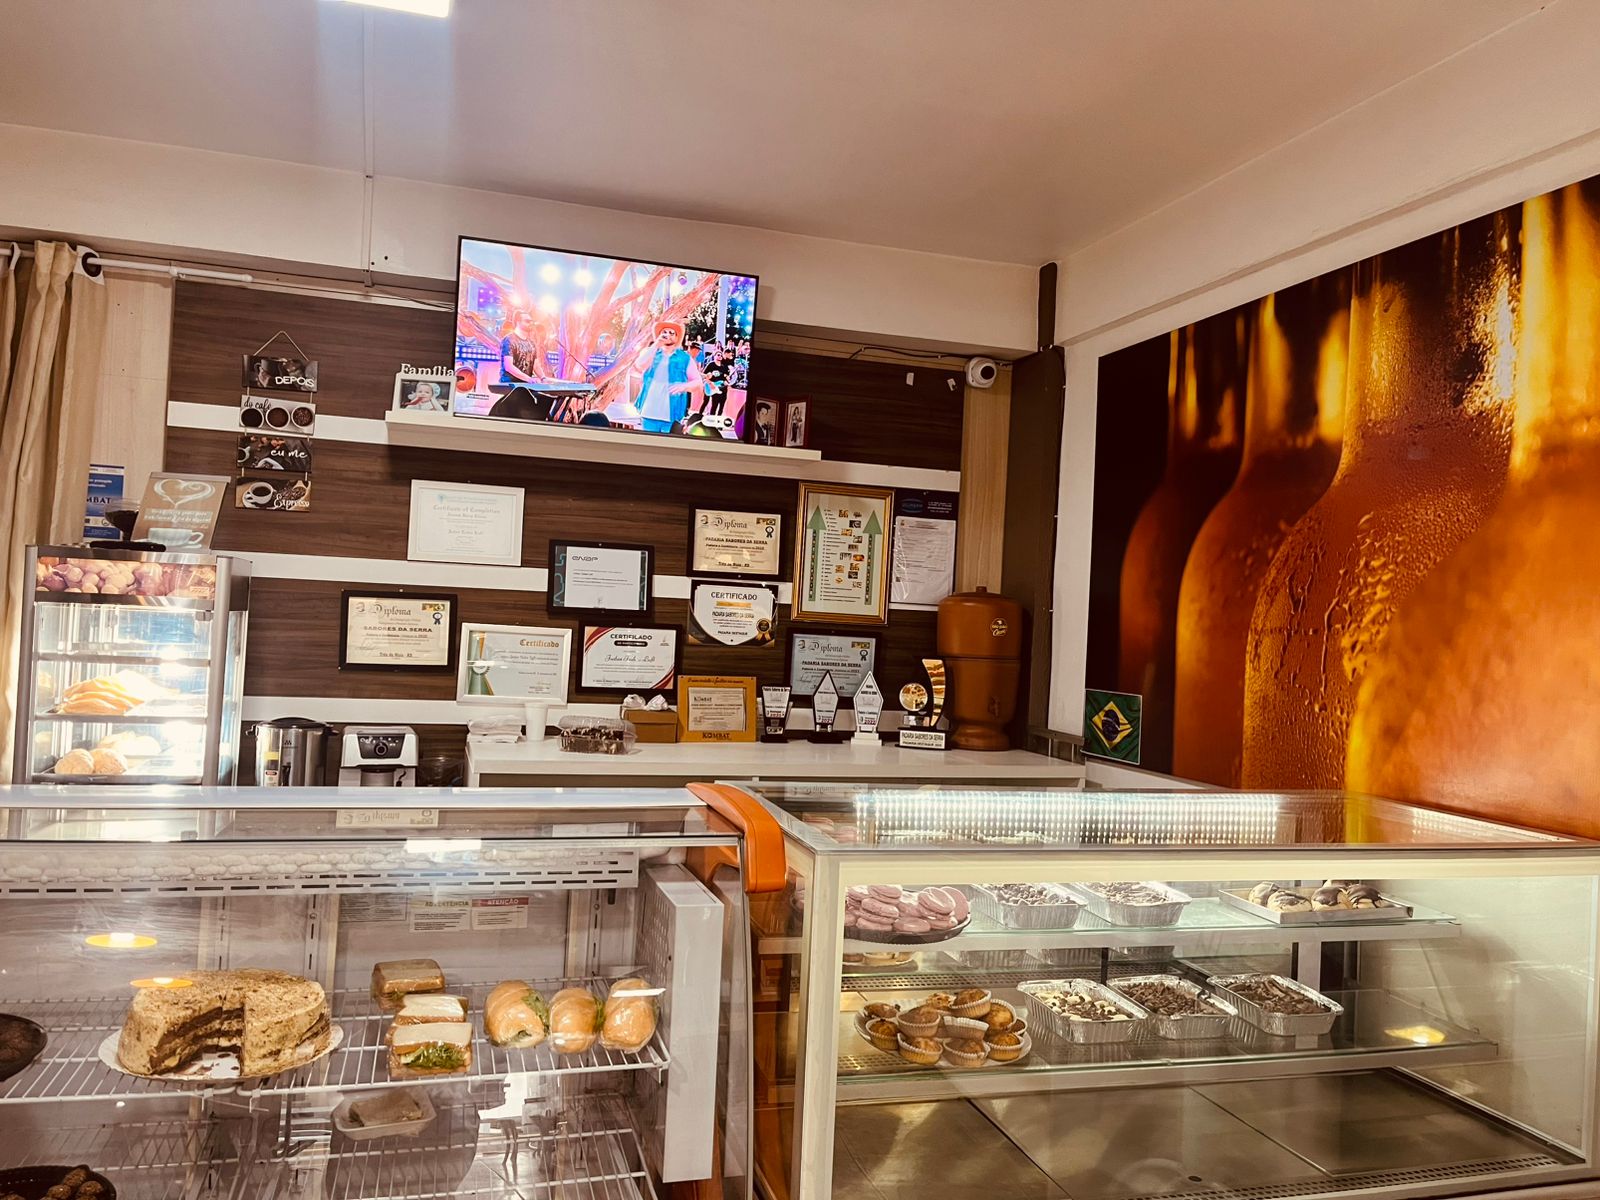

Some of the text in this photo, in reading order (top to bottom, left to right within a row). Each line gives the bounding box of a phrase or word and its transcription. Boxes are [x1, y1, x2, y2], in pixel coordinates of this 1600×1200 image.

[275, 376, 315, 388] DEPOIS
[244, 397, 253, 408] do
[271, 449, 308, 459] eu me
[712, 515, 747, 530] Diploma
[710, 591, 757, 600] CERTIFICADO
[369, 602, 411, 617] Diploma
[519, 638, 560, 648] Certificado
[808, 641, 843, 653] Diploma
